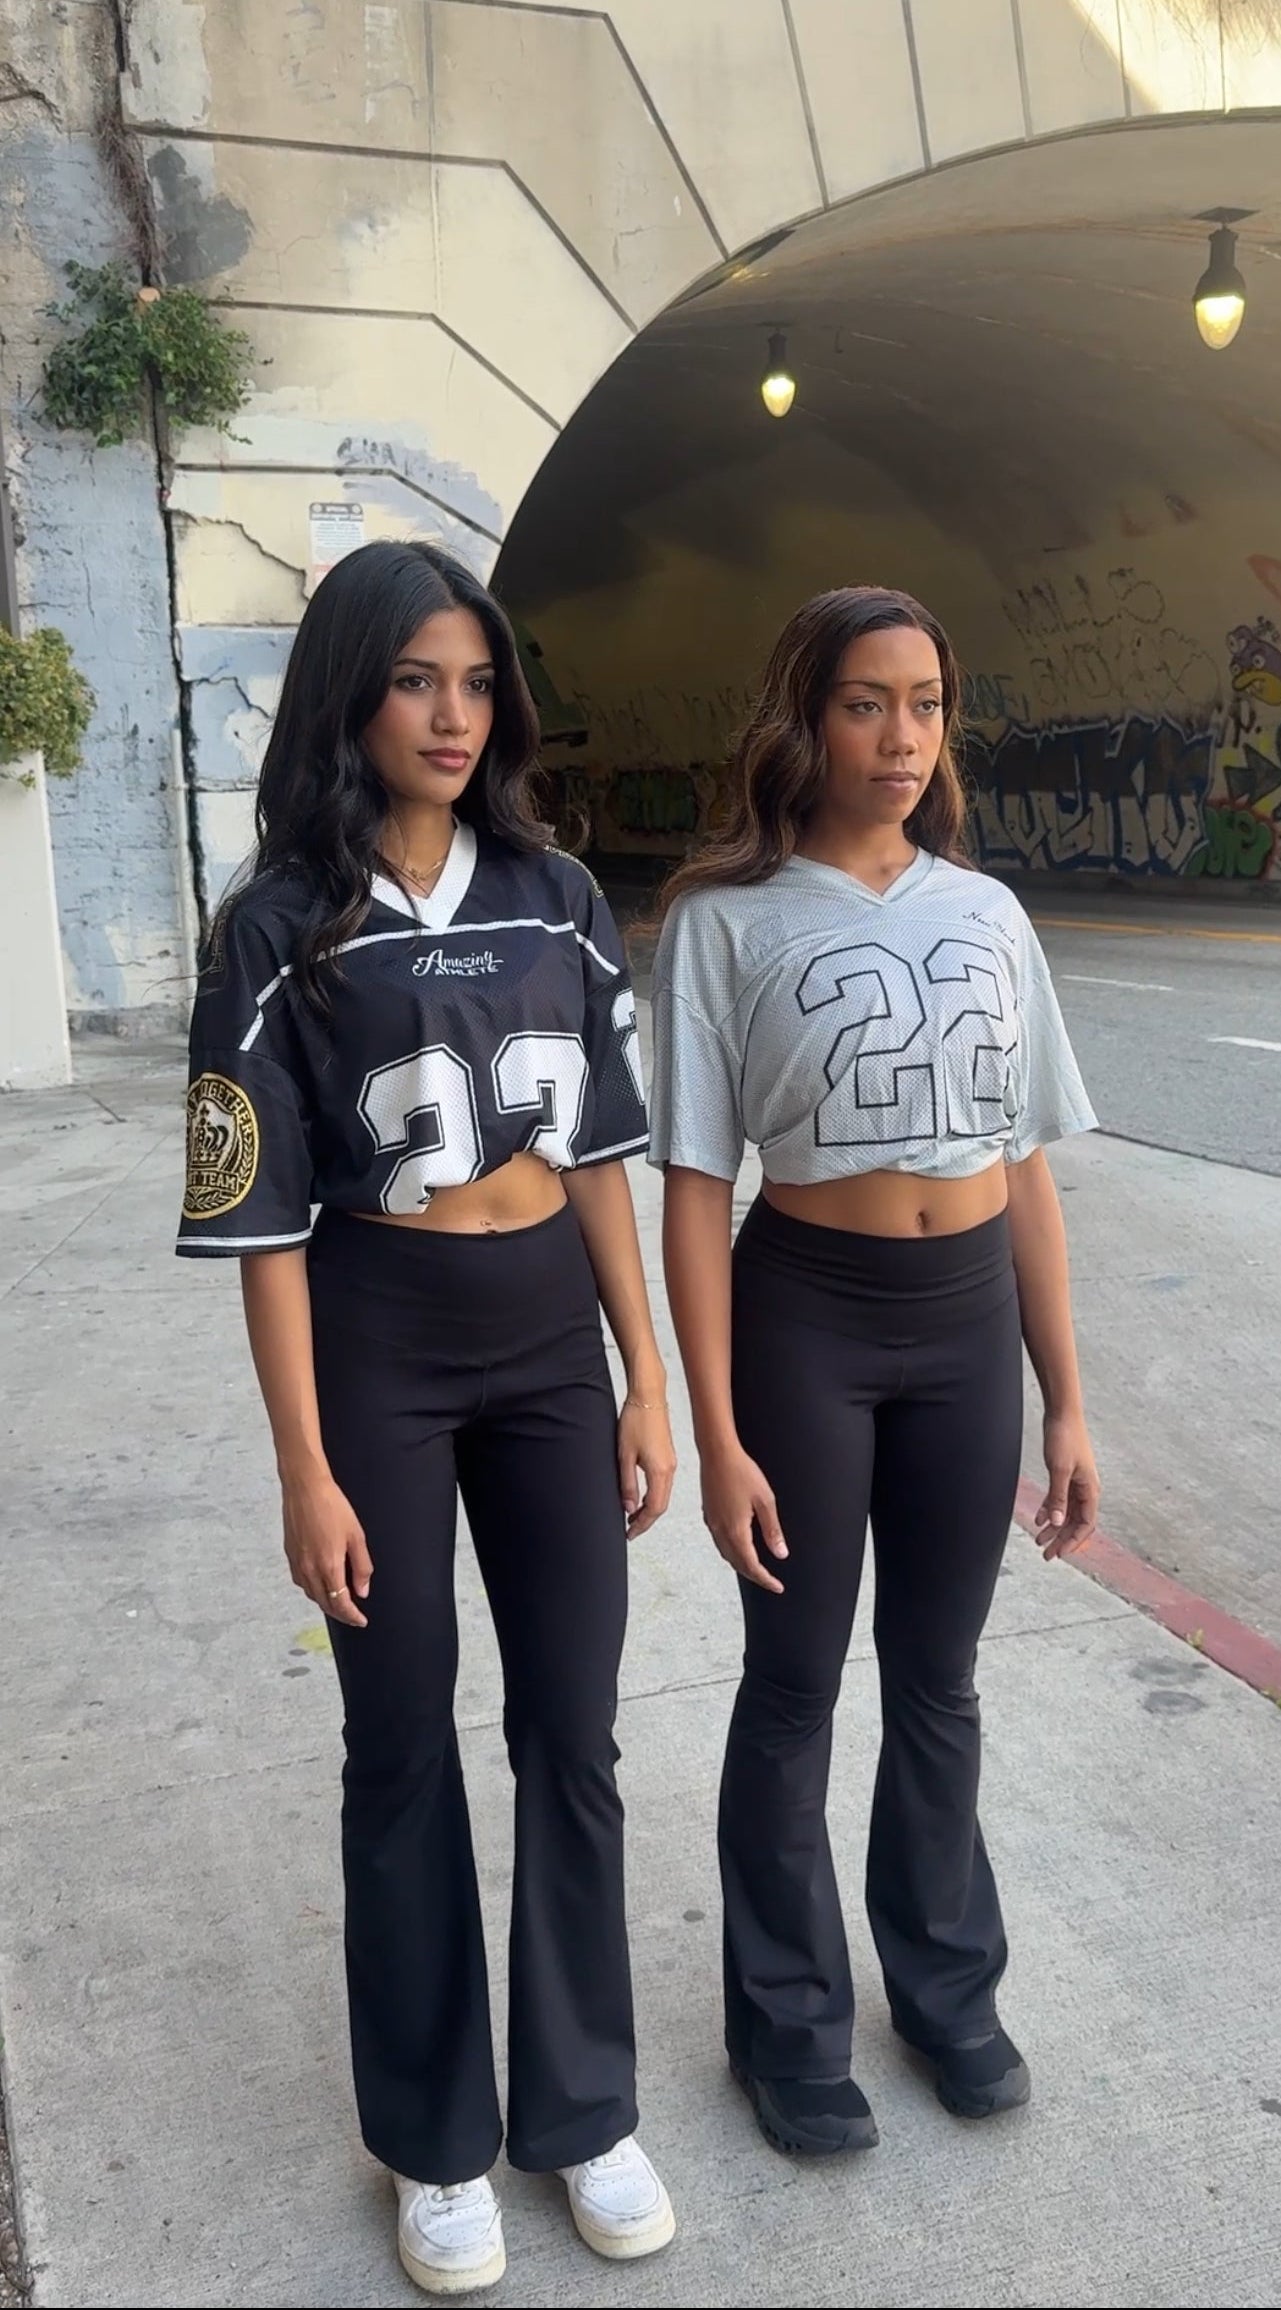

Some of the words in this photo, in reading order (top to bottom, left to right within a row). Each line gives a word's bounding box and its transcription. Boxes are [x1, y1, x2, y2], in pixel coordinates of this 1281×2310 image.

[412, 949, 505, 977] Amazing
[796, 938, 1018, 1147] 22
[201, 1171, 237, 1190] TEAM
